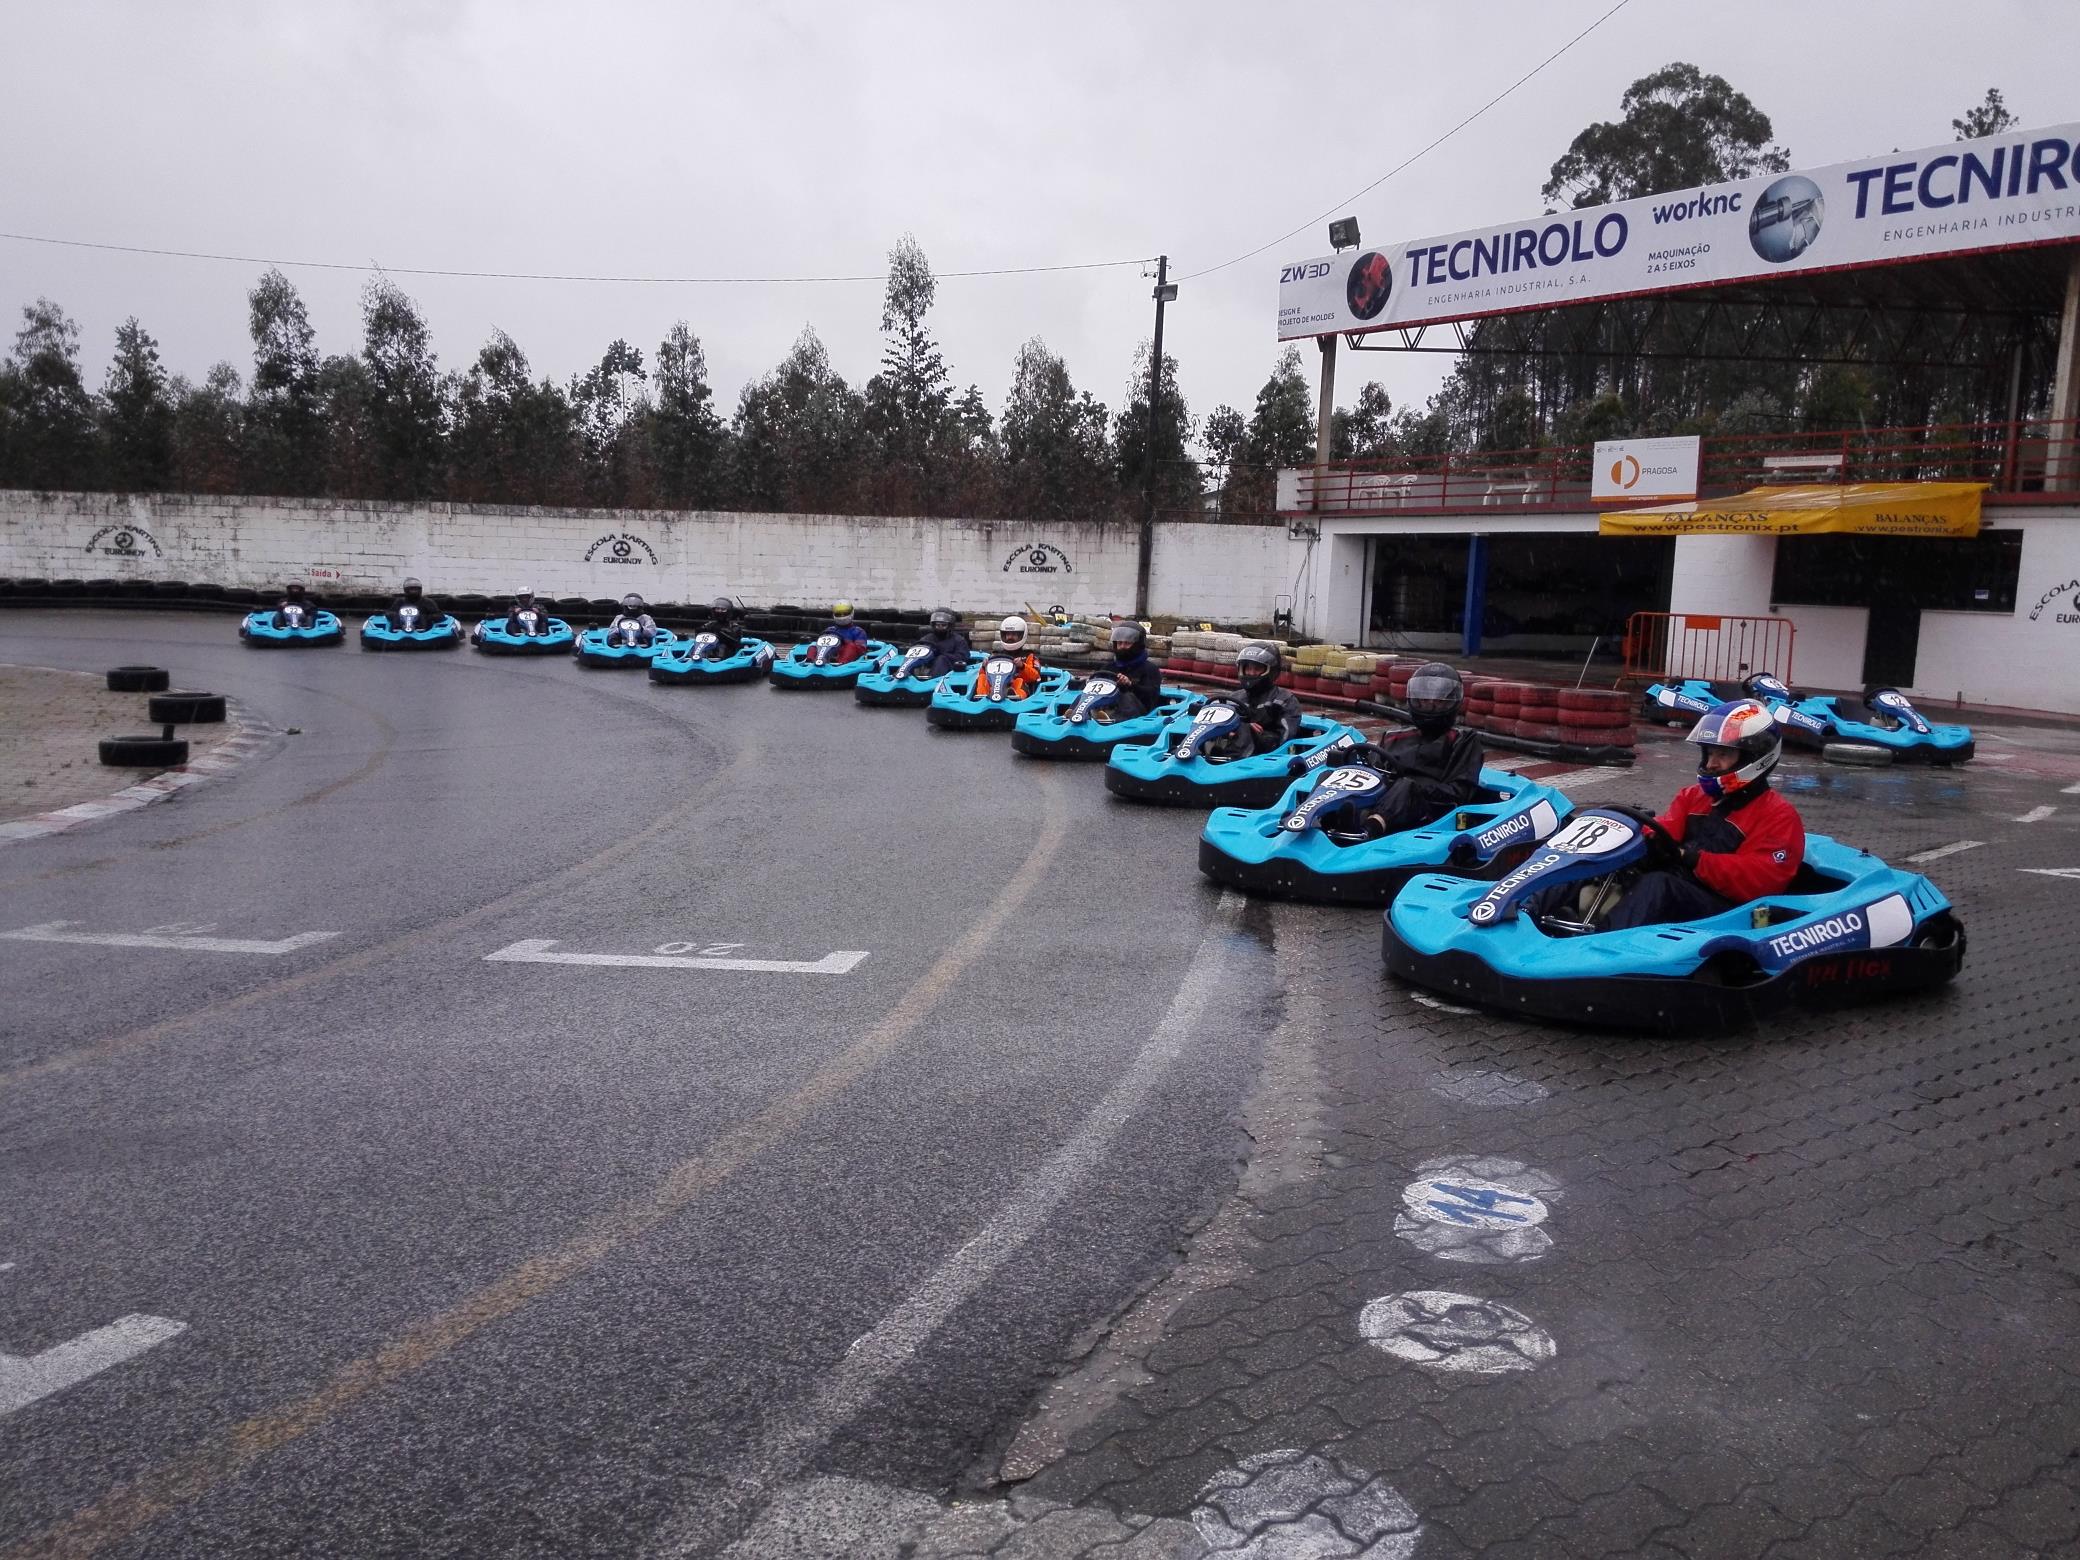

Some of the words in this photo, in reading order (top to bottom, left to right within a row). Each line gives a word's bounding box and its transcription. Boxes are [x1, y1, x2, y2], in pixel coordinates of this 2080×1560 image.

[1847, 139, 2080, 219] TECNIR
[1652, 191, 1743, 225] worknc
[1883, 218, 1988, 242] ENGENHARIA
[1406, 213, 1628, 287] TECNIROLO
[1648, 243, 1711, 262] MAQUINAÇÃO
[1647, 265, 1653, 274] 2
[1653, 264, 1661, 273] A
[1662, 263, 1667, 272] 5
[1669, 258, 1696, 271] EIXOS
[1428, 288, 1491, 305] ENGENHARIA
[1496, 279, 1563, 296] INDUSTRIAL,
[1569, 274, 1591, 286] S.A.
[1311, 313, 1335, 322] MOLDES
[1641, 466, 1678, 475] PRAGOSA
[1662, 511, 1769, 524] BALANÇAS
[1875, 513, 1947, 525] BALANÇAS
[1633, 522, 1800, 533] www.pestronix.pt
[584, 534, 616, 562] ESCOLA
[622, 533, 659, 565] KARTING
[603, 556, 642, 565] EUROINDY
[1003, 543, 1033, 572] ESCOLA
[1038, 543, 1073, 573] KARTING
[1020, 565, 1058, 573] EUROINDY
[2029, 579, 2080, 621] ESCOLA
[523, 612, 532, 620] 21
[2056, 613, 2080, 624] EUR
[820, 637, 832, 646] 32
[909, 648, 921, 657] 24
[996, 662, 1001, 672] 1
[1090, 682, 1104, 695] 13
[1678, 695, 1709, 712] TECNIROLO
[1203, 710, 1217, 722] 11
[1791, 711, 1822, 729] TECNIROLO
[1329, 771, 1370, 788] 25
[1478, 814, 1530, 849] TECNIROLO
[1566, 821, 1609, 848] 18
[1488, 853, 1560, 902] TECNIROLO
[1769, 912, 1862, 958] TECNIROLO
